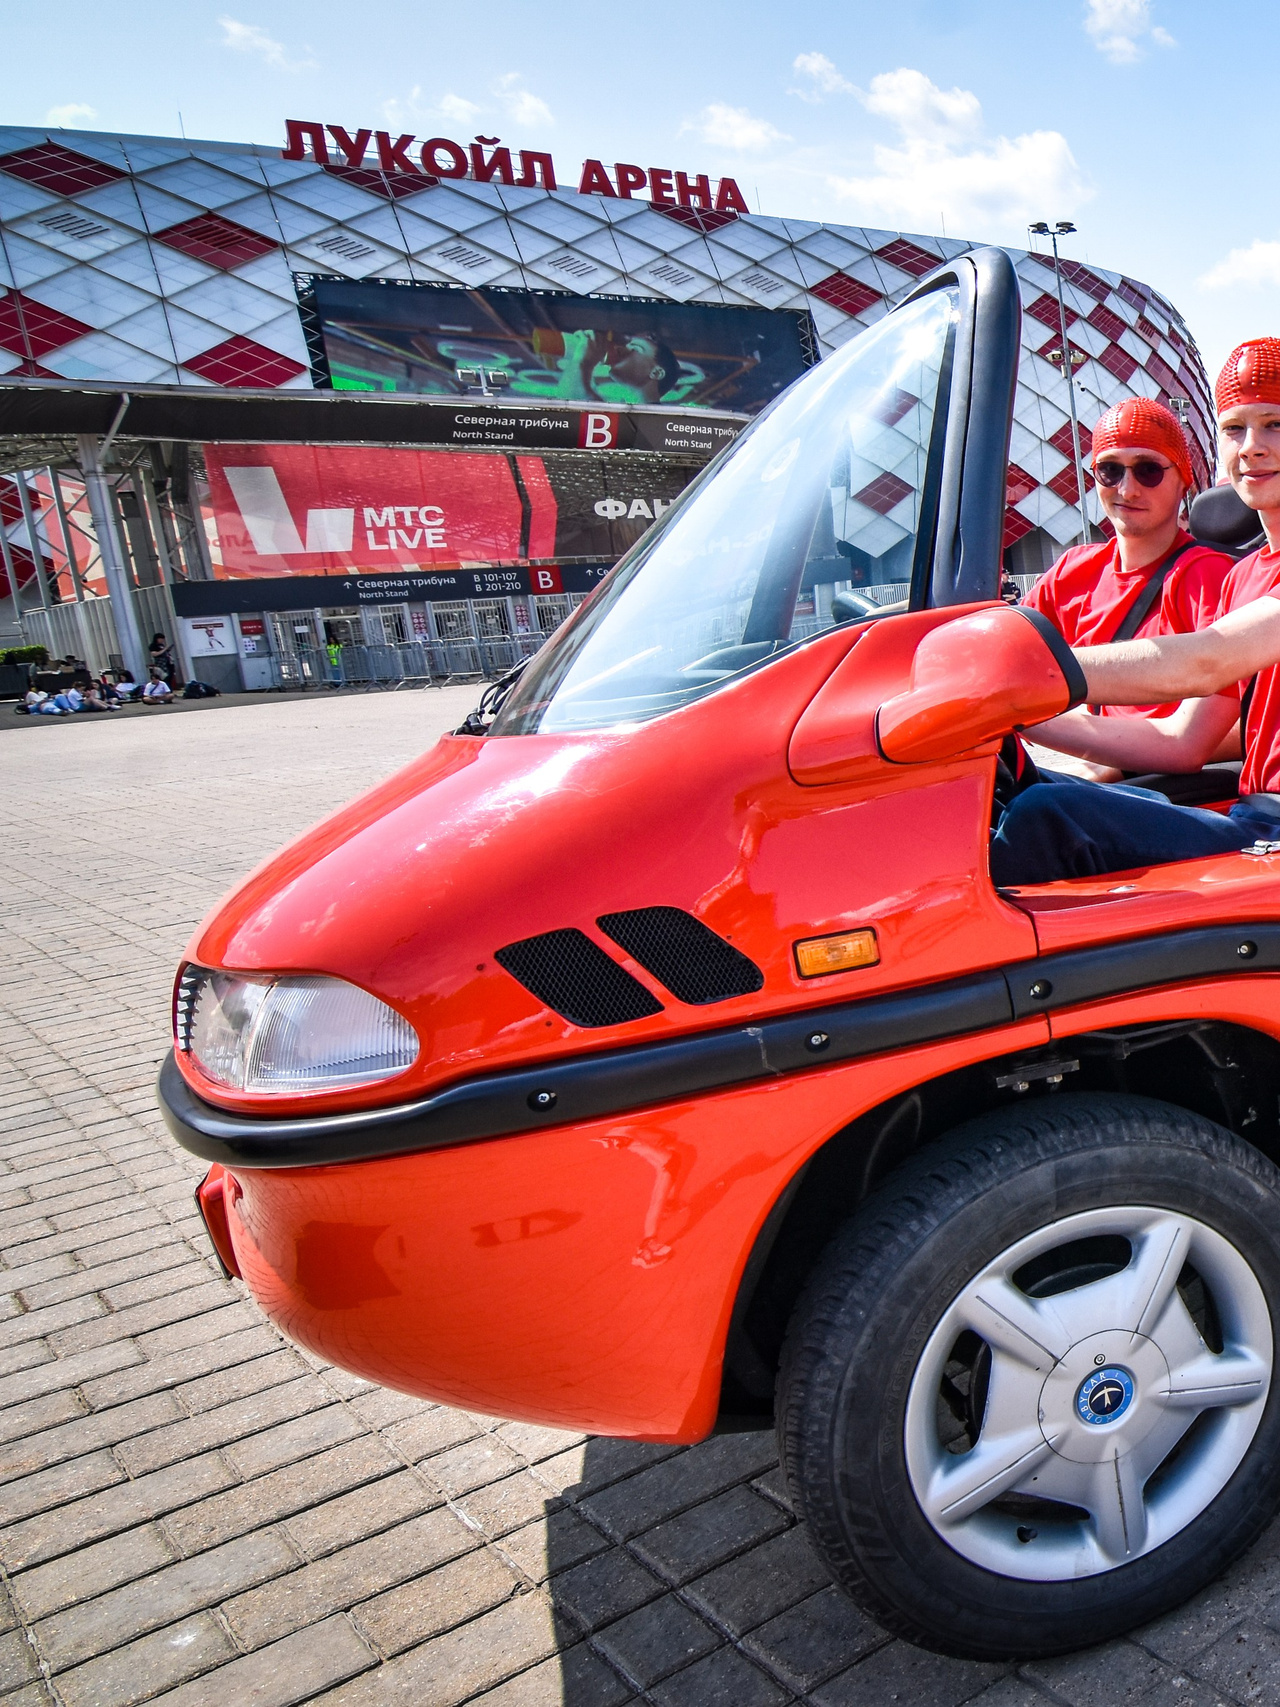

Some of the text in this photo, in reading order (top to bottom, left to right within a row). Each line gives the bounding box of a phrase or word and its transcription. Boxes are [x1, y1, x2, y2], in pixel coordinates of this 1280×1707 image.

[280, 118, 750, 214] ЛУКОЙЛ АРЕНА
[454, 413, 569, 430] Северная трибуна
[665, 421, 713, 436] Северная
[452, 430, 514, 441] North Stand
[664, 438, 712, 450] North Stand
[363, 506, 446, 528] МТС
[366, 528, 448, 551] LIVE
[356, 576, 457, 590] Северная трибуна
[483, 572, 518, 582] 101-107
[485, 581, 522, 591] 201-210
[359, 589, 409, 599] North Stand
